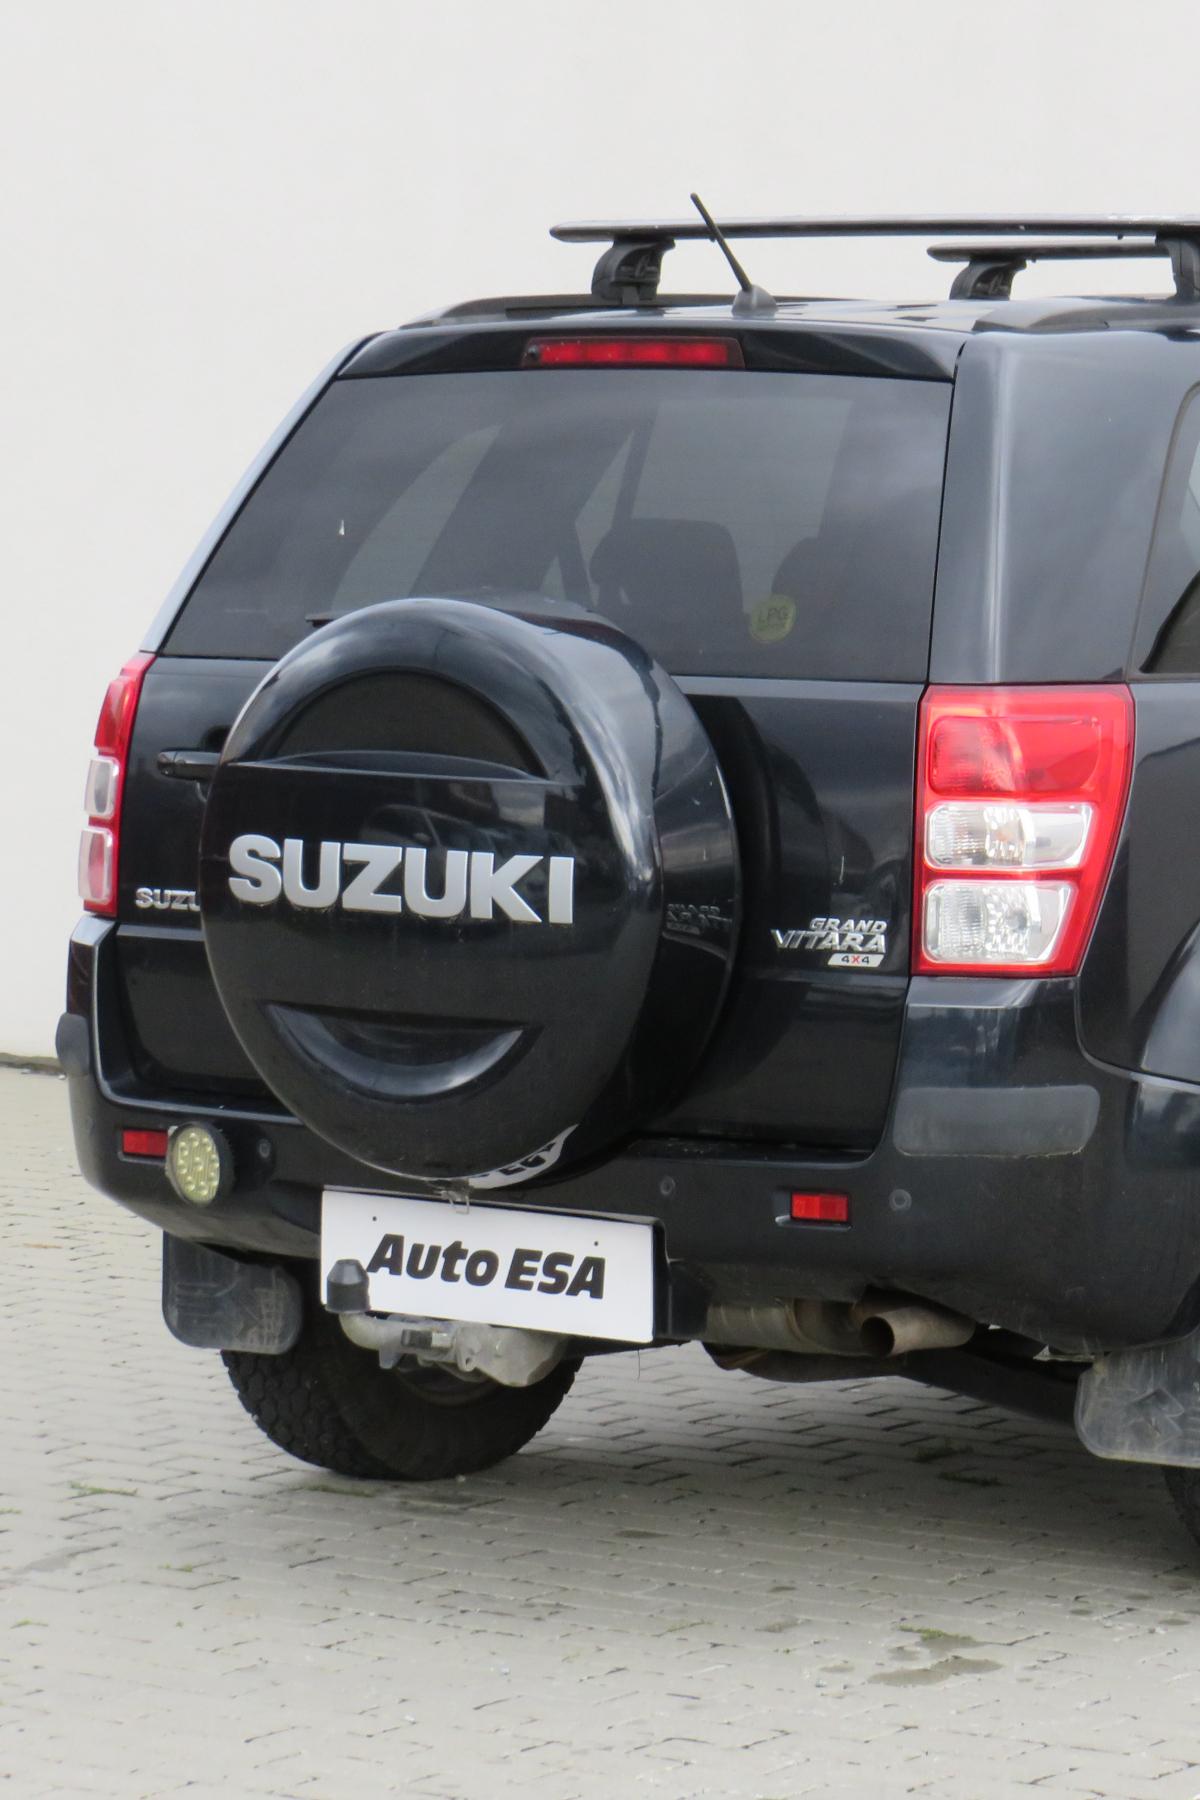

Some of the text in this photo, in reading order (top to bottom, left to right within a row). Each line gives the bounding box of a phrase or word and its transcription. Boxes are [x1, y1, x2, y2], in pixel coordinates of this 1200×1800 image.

[228, 833, 575, 925] SUZUKI
[770, 929, 886, 953] VITARA
[809, 917, 887, 934] GRAND
[366, 1233, 606, 1299] Auto ESA
